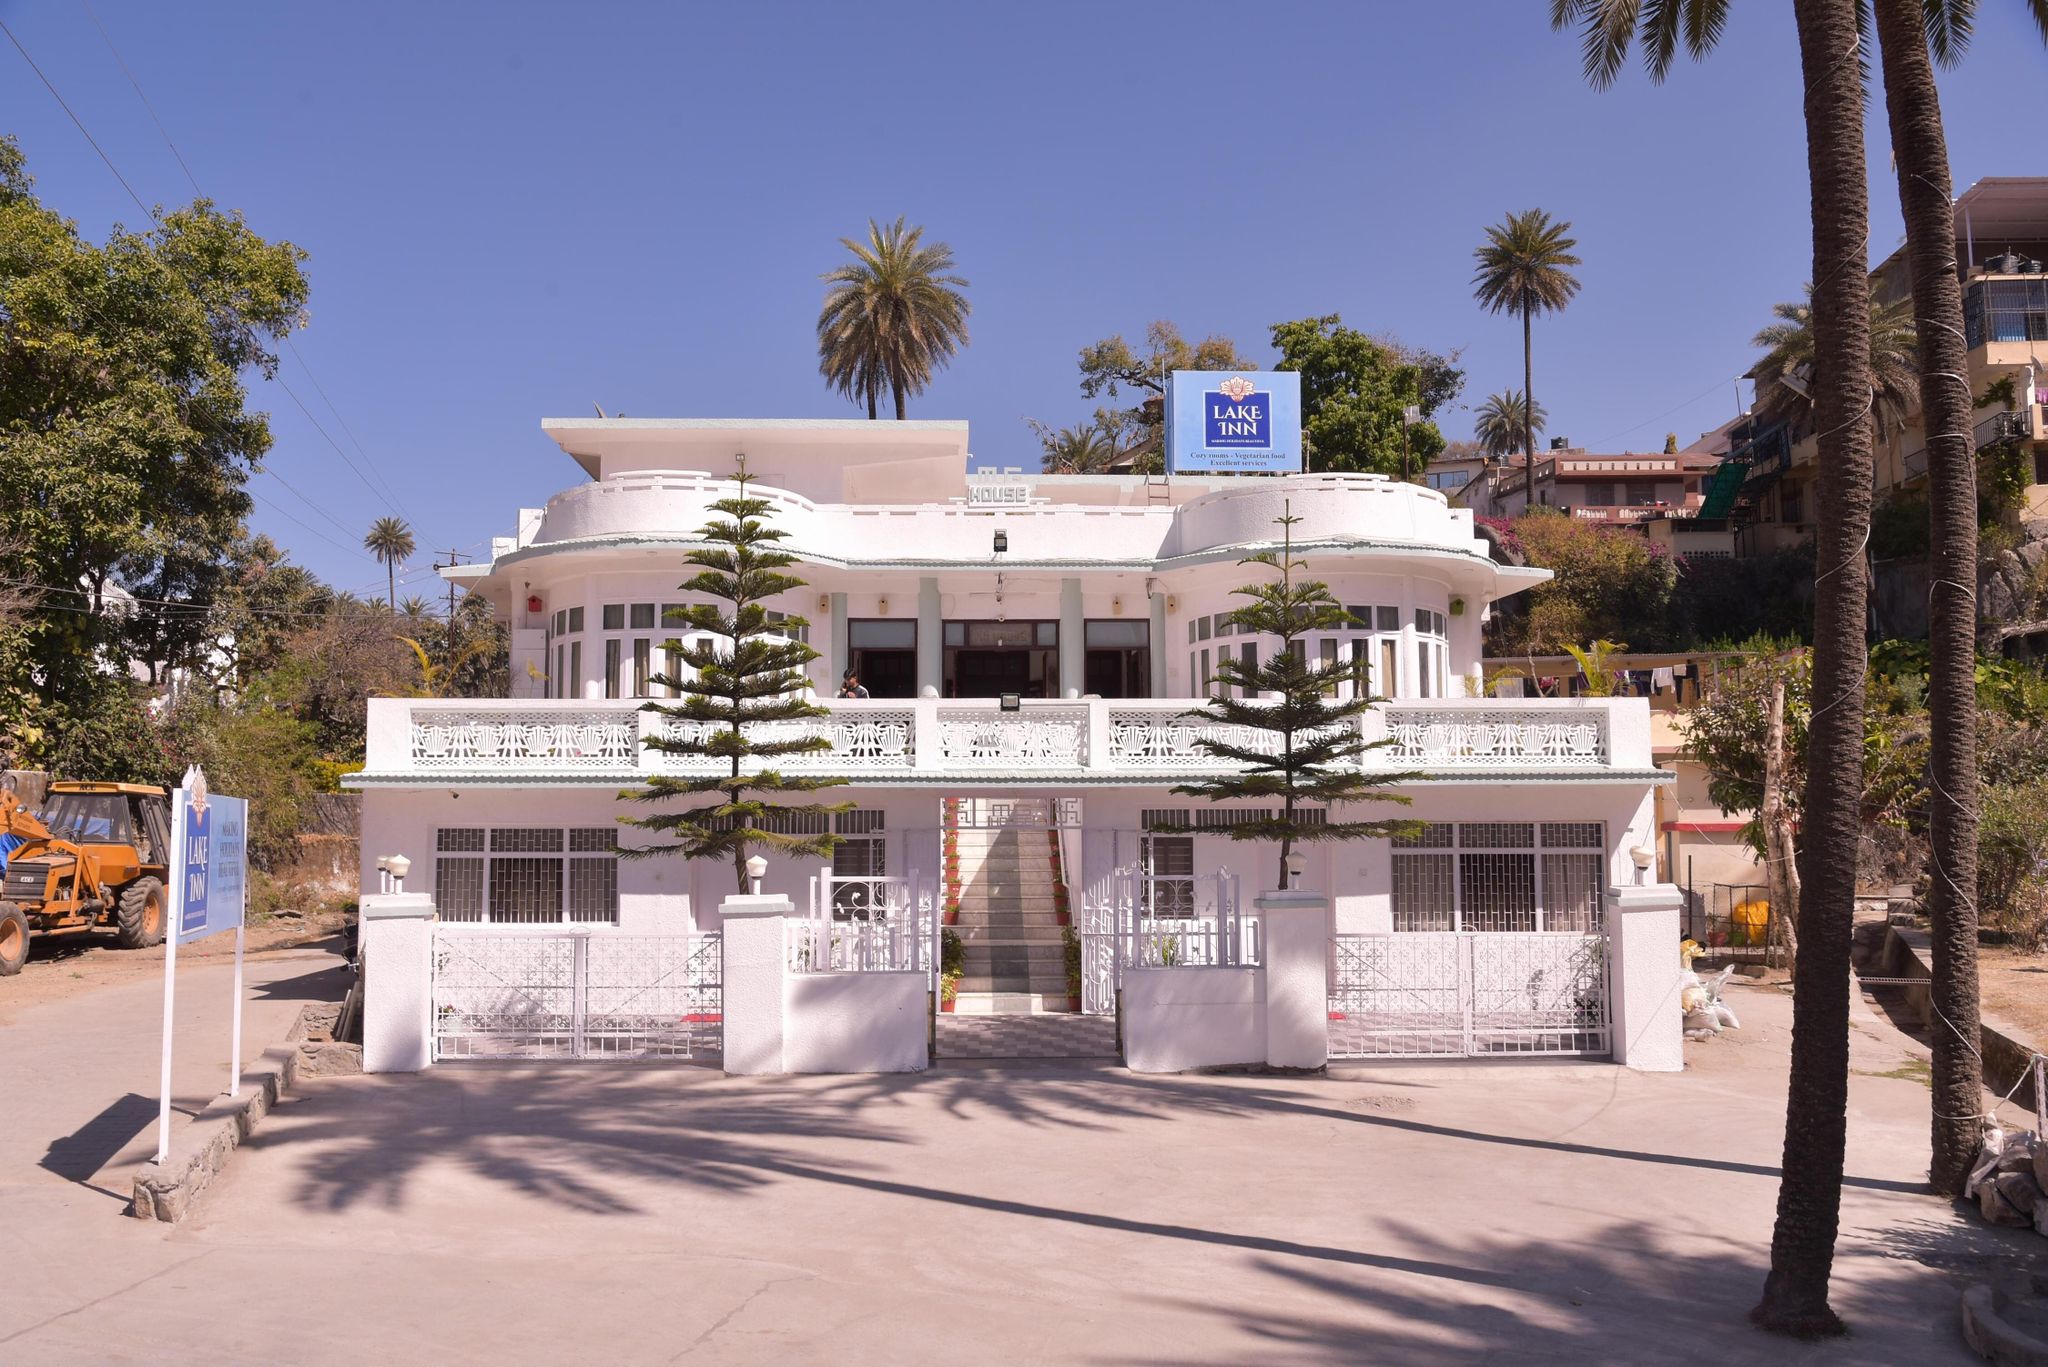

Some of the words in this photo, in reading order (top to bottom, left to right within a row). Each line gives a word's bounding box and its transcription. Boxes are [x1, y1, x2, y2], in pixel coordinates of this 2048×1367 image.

[1214, 405, 1263, 423] LAKE
[1218, 422, 1258, 436] INN
[1190, 452, 1207, 460] Cozy
[1235, 452, 1270, 460] Vegetarian
[969, 486, 1027, 503] HOUSE
[80, 783, 96, 791] ACE
[188, 836, 208, 871] LAKE
[189, 873, 205, 902] INN
